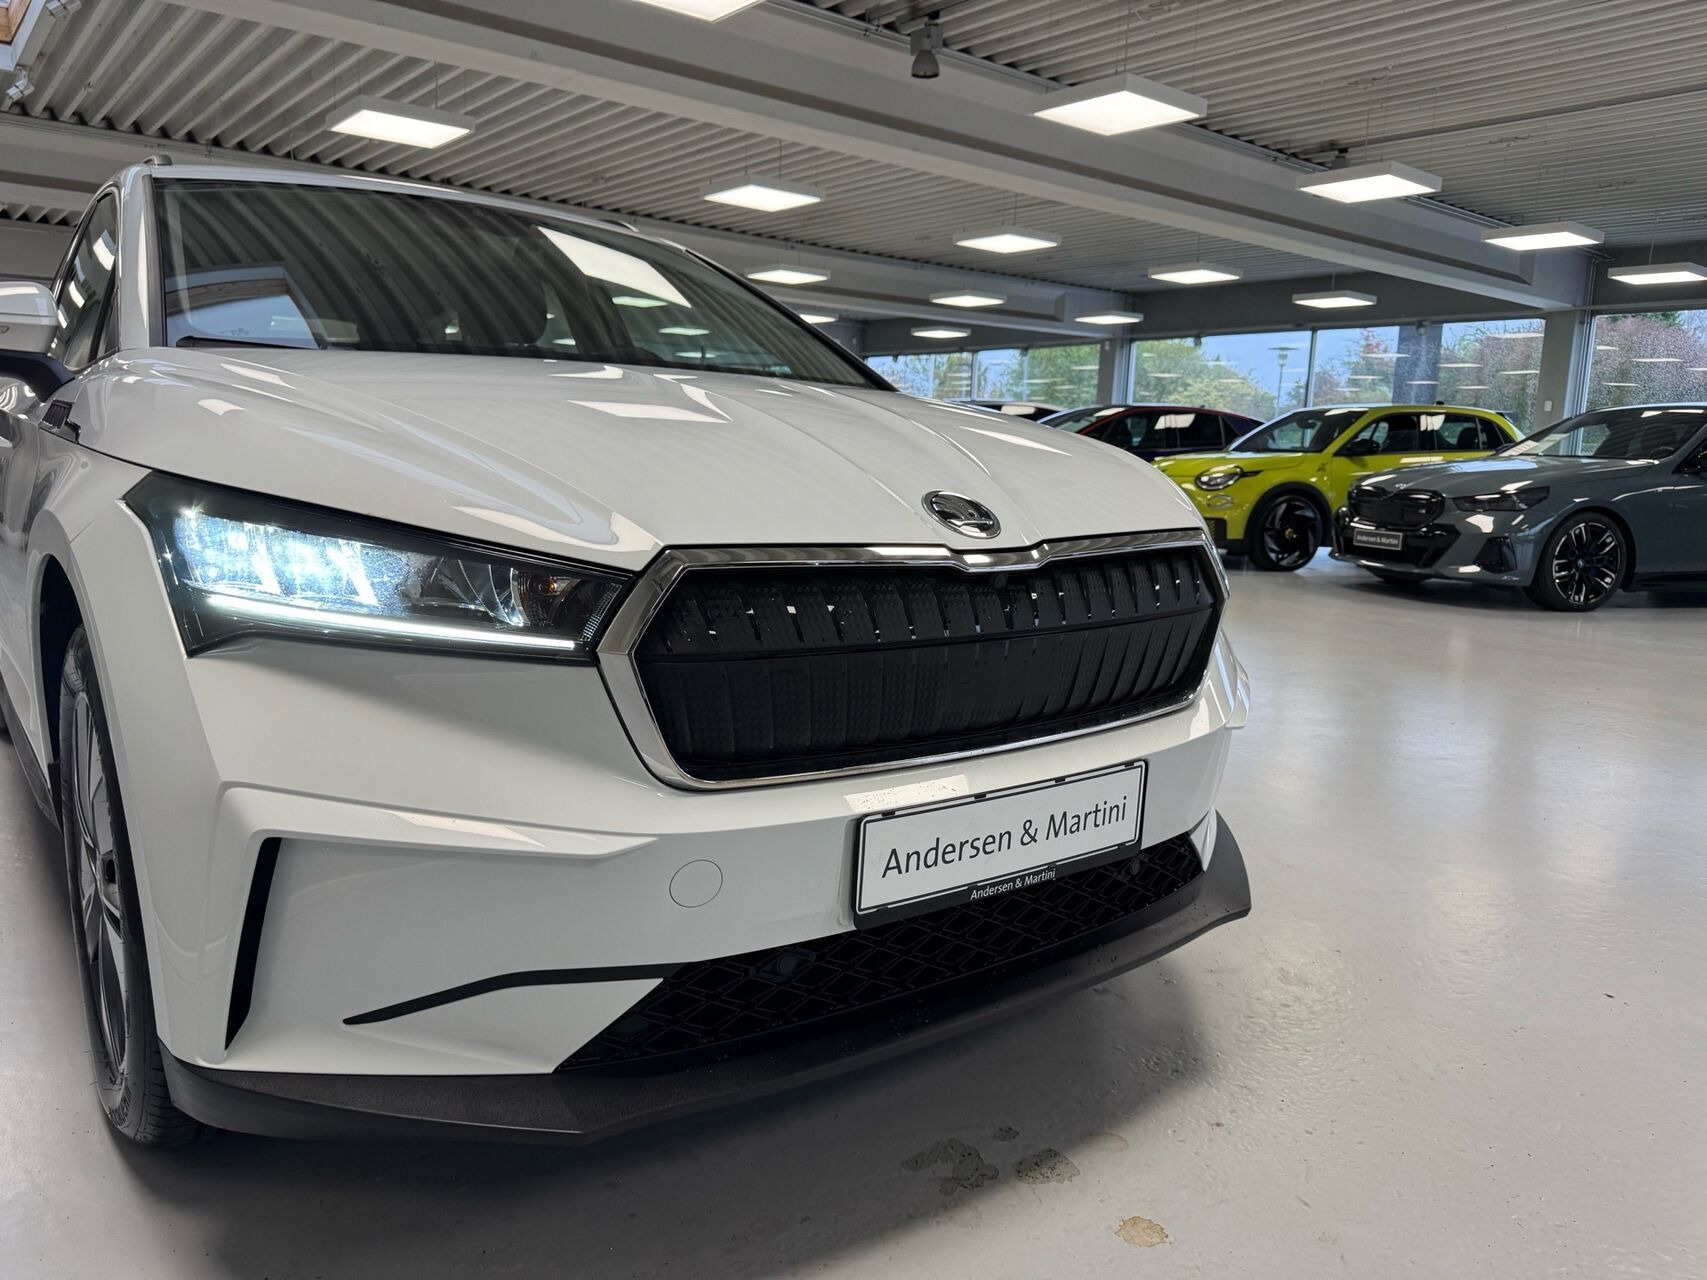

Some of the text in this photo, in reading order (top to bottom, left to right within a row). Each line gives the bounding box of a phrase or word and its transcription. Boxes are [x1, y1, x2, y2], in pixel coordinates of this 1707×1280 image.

[881, 795, 1128, 878] Andersen & Martini
[970, 868, 1056, 900] Andersen & Martini
